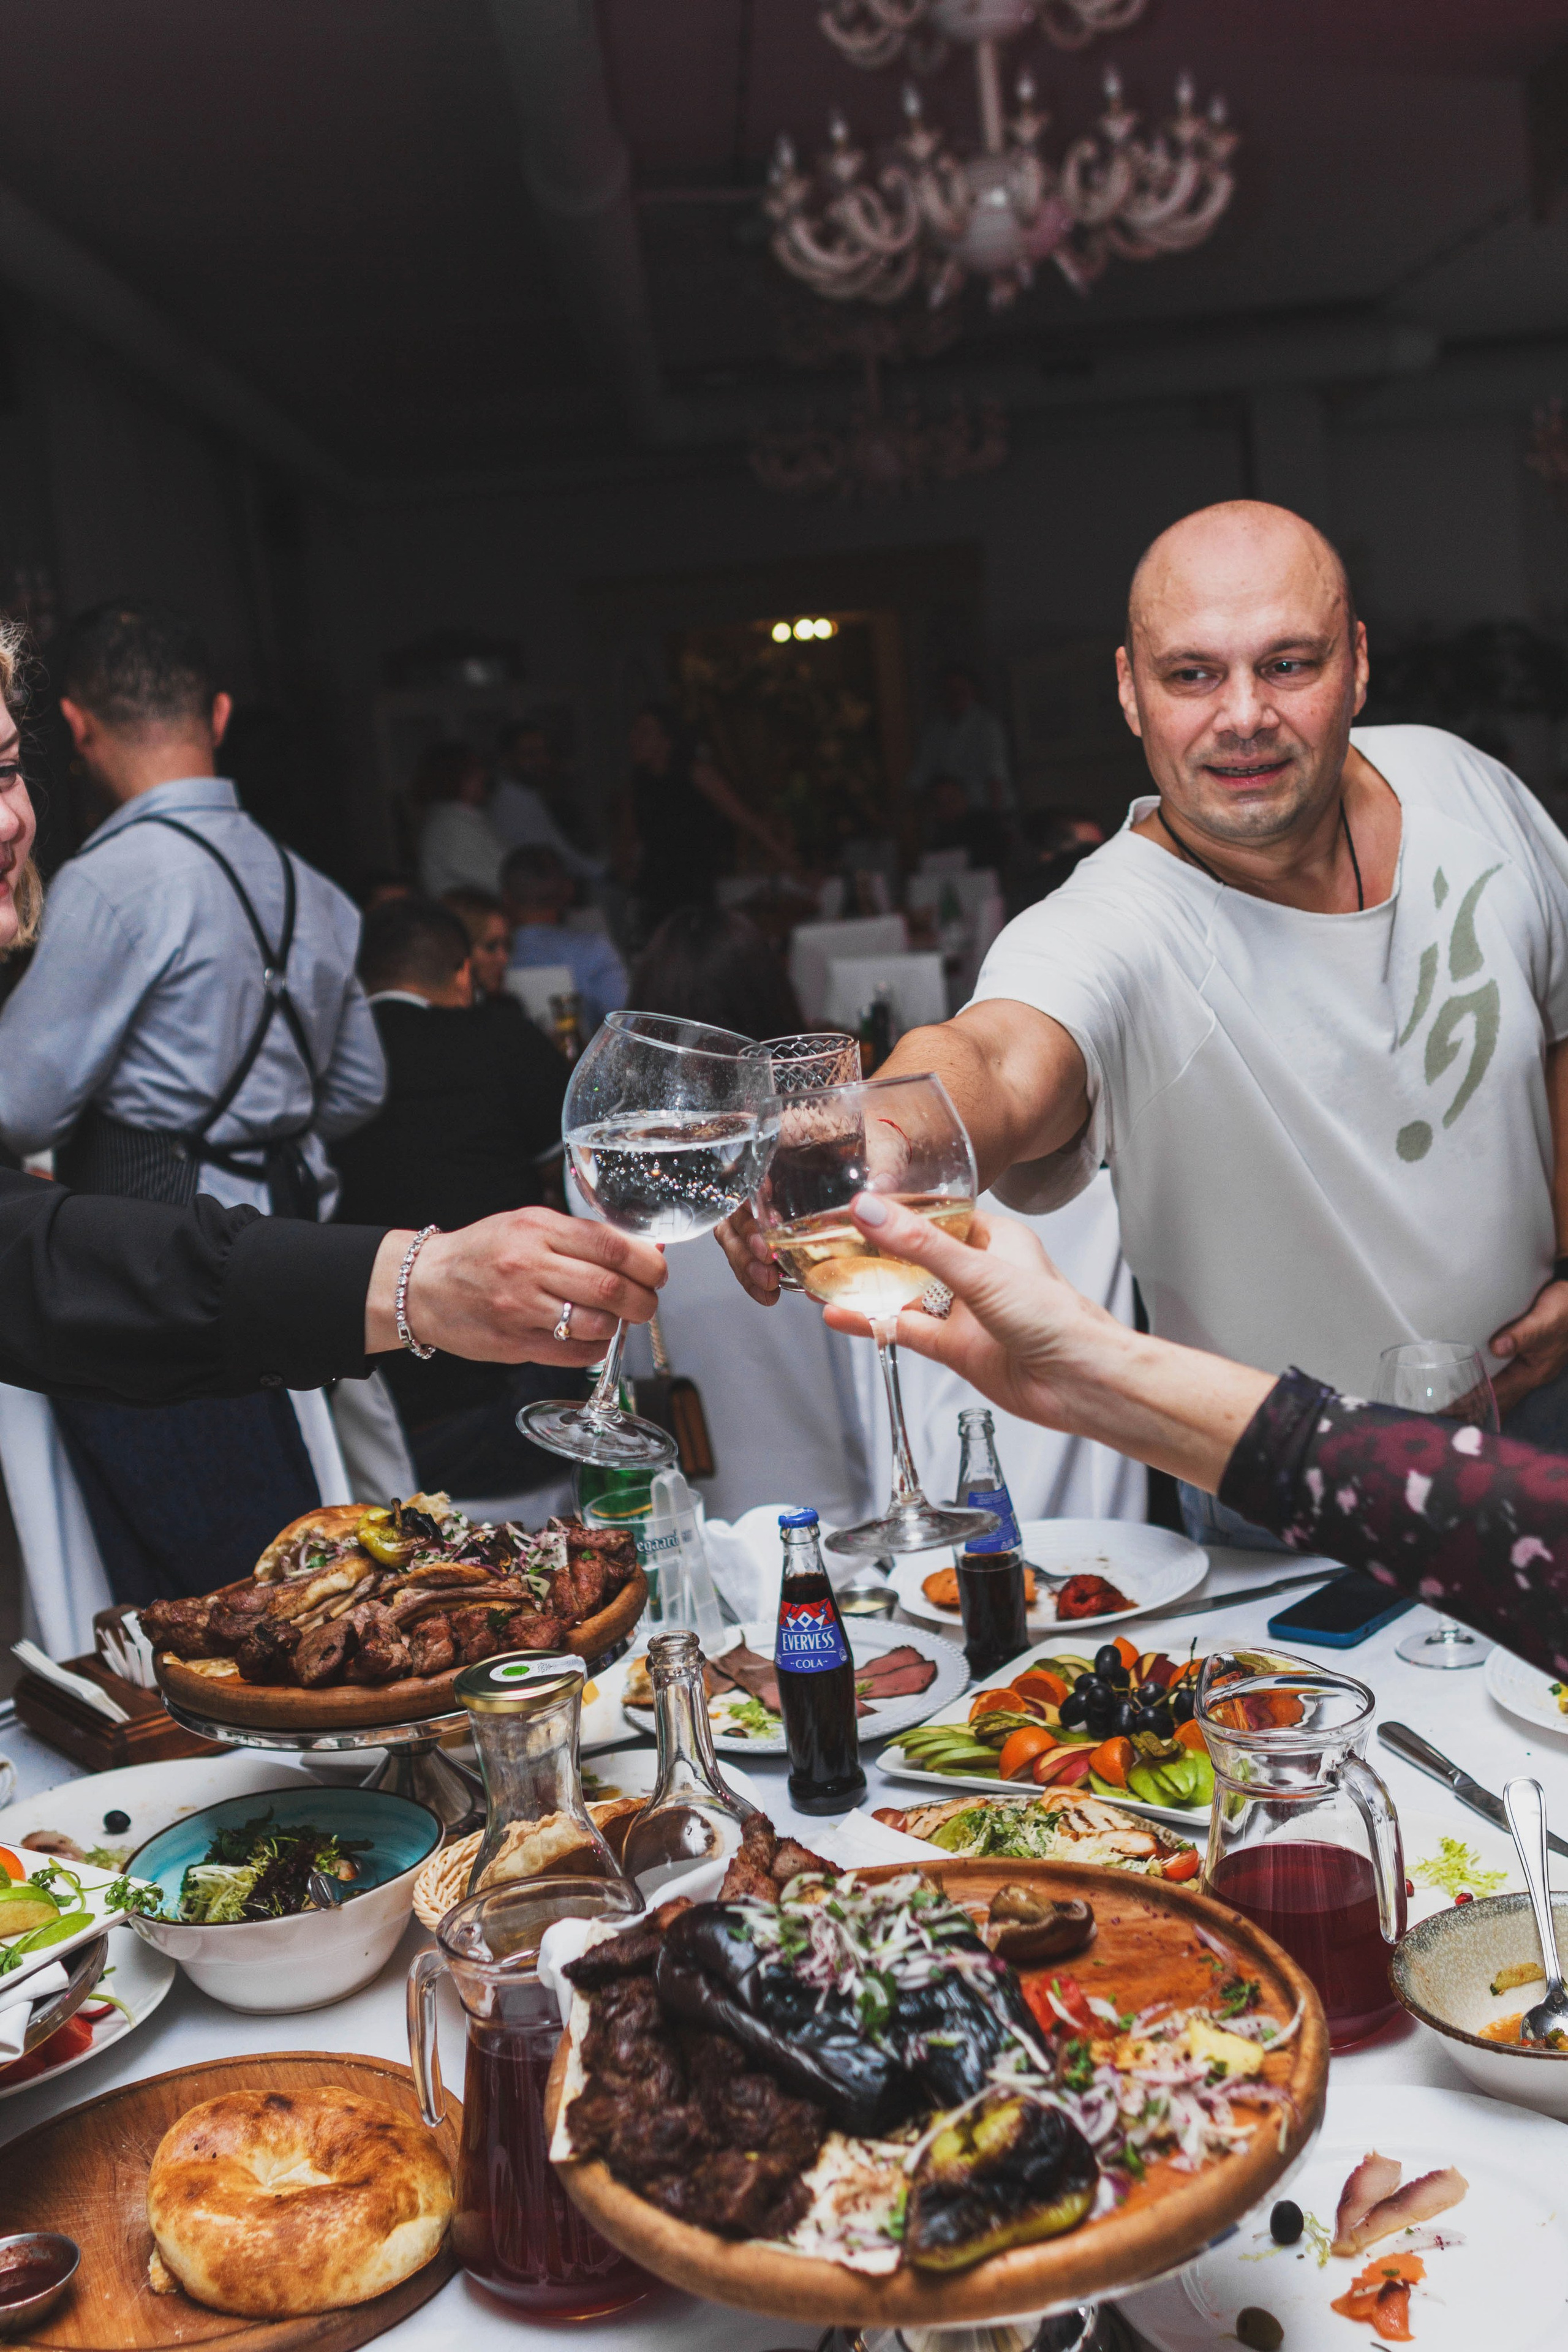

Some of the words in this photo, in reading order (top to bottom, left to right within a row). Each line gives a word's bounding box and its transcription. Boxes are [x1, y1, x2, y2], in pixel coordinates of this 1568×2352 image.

[636, 1529, 679, 1555] egaard
[782, 1630, 834, 1651] EVERVESS
[795, 1659, 824, 1669] COLA
